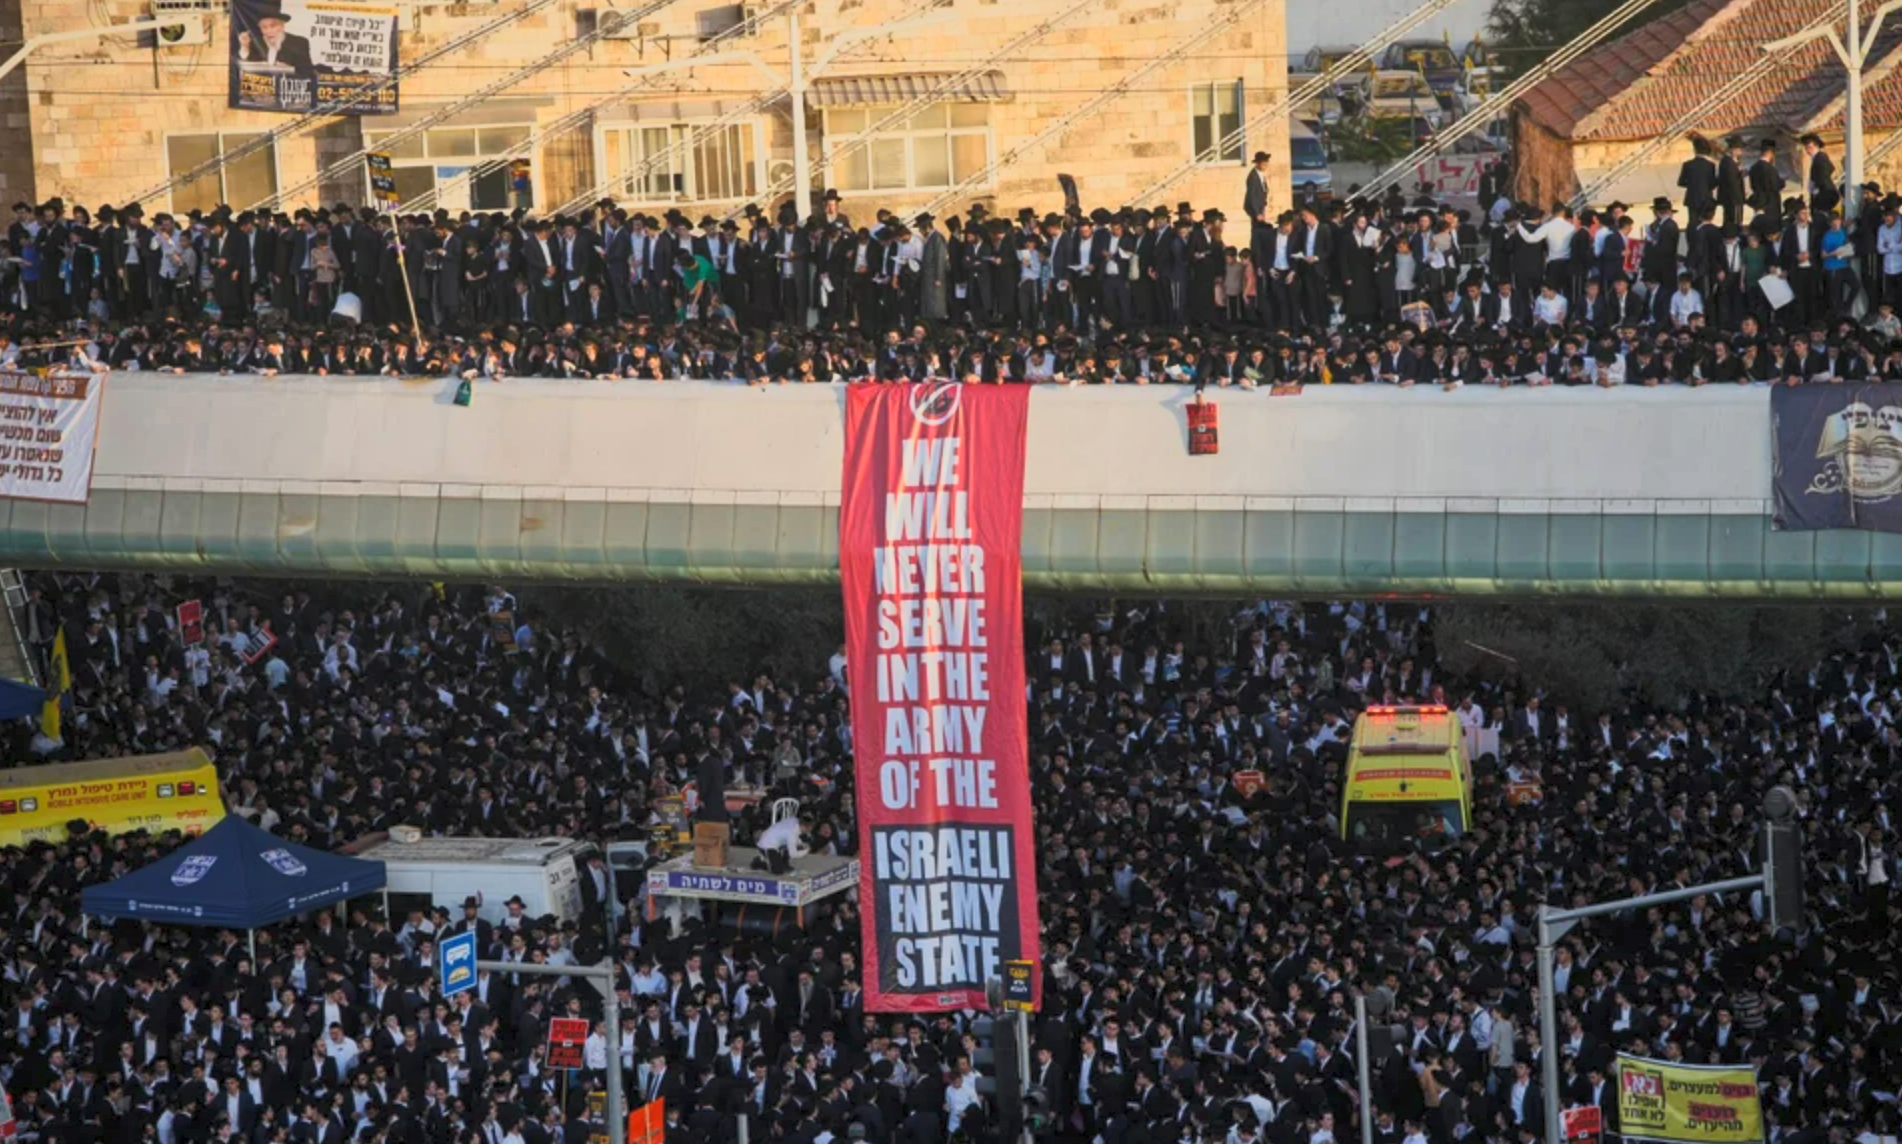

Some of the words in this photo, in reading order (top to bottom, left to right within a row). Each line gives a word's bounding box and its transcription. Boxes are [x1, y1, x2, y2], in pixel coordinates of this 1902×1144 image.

[36, 427, 62, 443] שום
[903, 437, 960, 487] WE
[13, 463, 44, 481] גדולי
[48, 465, 63, 482] כל
[886, 491, 972, 541] WILL
[874, 544, 986, 595] NEVER
[877, 598, 988, 649] SERVE
[877, 654, 919, 702] IN
[921, 652, 990, 701] THE
[885, 705, 986, 755] ARMY
[81, 782, 113, 794] טיפול
[118, 780, 147, 791] ניידת
[880, 760, 920, 810] OF
[929, 758, 998, 808] THE
[47, 788, 78, 799] נמרץ
[75, 794, 110, 807] INTENSIVE
[111, 793, 129, 804] CARE
[130, 791, 147, 801] UNIT
[875, 828, 1011, 880] ISRAELI
[681, 874, 731, 892] לשתיה
[737, 880, 766, 894] מים
[889, 881, 1004, 933] ENEMY
[896, 934, 1002, 987] STATE
[1623, 1107, 1648, 1119] אחד
[1651, 1107, 1666, 1121] לא
